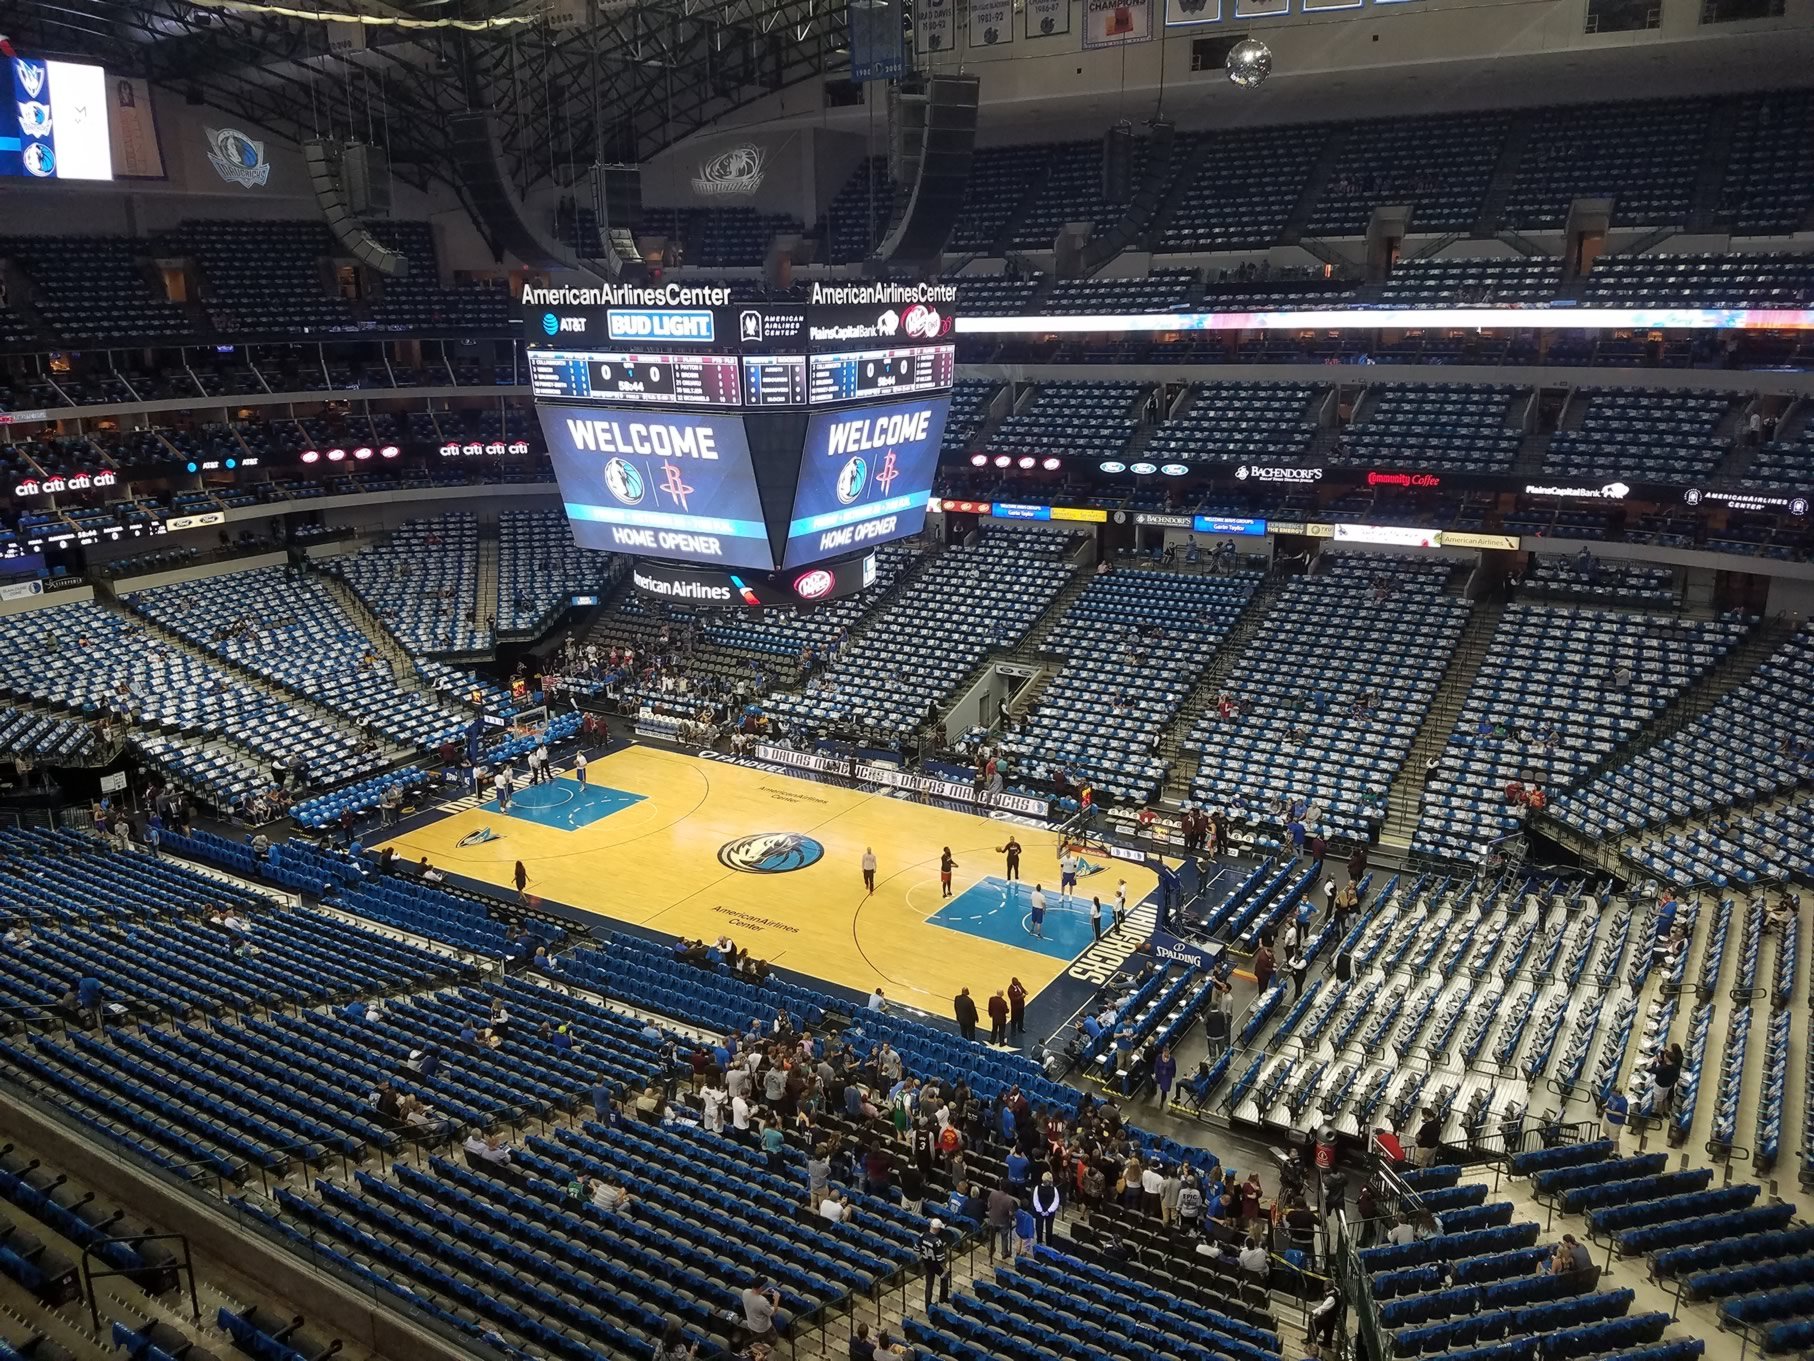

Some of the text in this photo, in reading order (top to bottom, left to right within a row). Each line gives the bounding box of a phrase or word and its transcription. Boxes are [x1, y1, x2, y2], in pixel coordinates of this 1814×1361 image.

[521, 283, 731, 306] AmericanAirlinesCenter
[812, 282, 957, 305] AmericanAirlinesCenter
[560, 318, 587, 332] AT&T
[611, 315, 711, 337] BUD LIGHT
[601, 364, 612, 380] 0
[649, 366, 660, 382] 0
[866, 363, 874, 378] 0
[900, 360, 908, 374] 0
[566, 419, 719, 460] WELCOME
[827, 410, 931, 456] WELCOME
[440, 443, 460, 457] citi
[462, 442, 483, 456] citi
[486, 442, 505, 455] citi
[508, 441, 528, 455] citi
[93, 473, 116, 487] citi
[1251, 466, 1323, 480] BACHENDORF'S
[1368, 471, 1440, 486] Community Coffee
[15, 482, 39, 496] citi
[42, 479, 65, 493] citi
[68, 476, 91, 489] citi
[819, 515, 898, 551] HOME OPENER
[1444, 535, 1504, 546] American Airlines
[612, 527, 723, 555] HOME OPENER
[672, 581, 731, 600] Airlines
[715, 754, 787, 774] FANDUEL
[771, 749, 811, 766] DALLAS
[900, 775, 945, 793] DALLAS
[771, 794, 800, 803] Center
[711, 905, 800, 934] AmericanAirlines
[728, 918, 765, 932] Center
[1156, 945, 1202, 968] SPALDING
[919, 1141, 926, 1151] 3
[922, 1245, 936, 1260] 34
